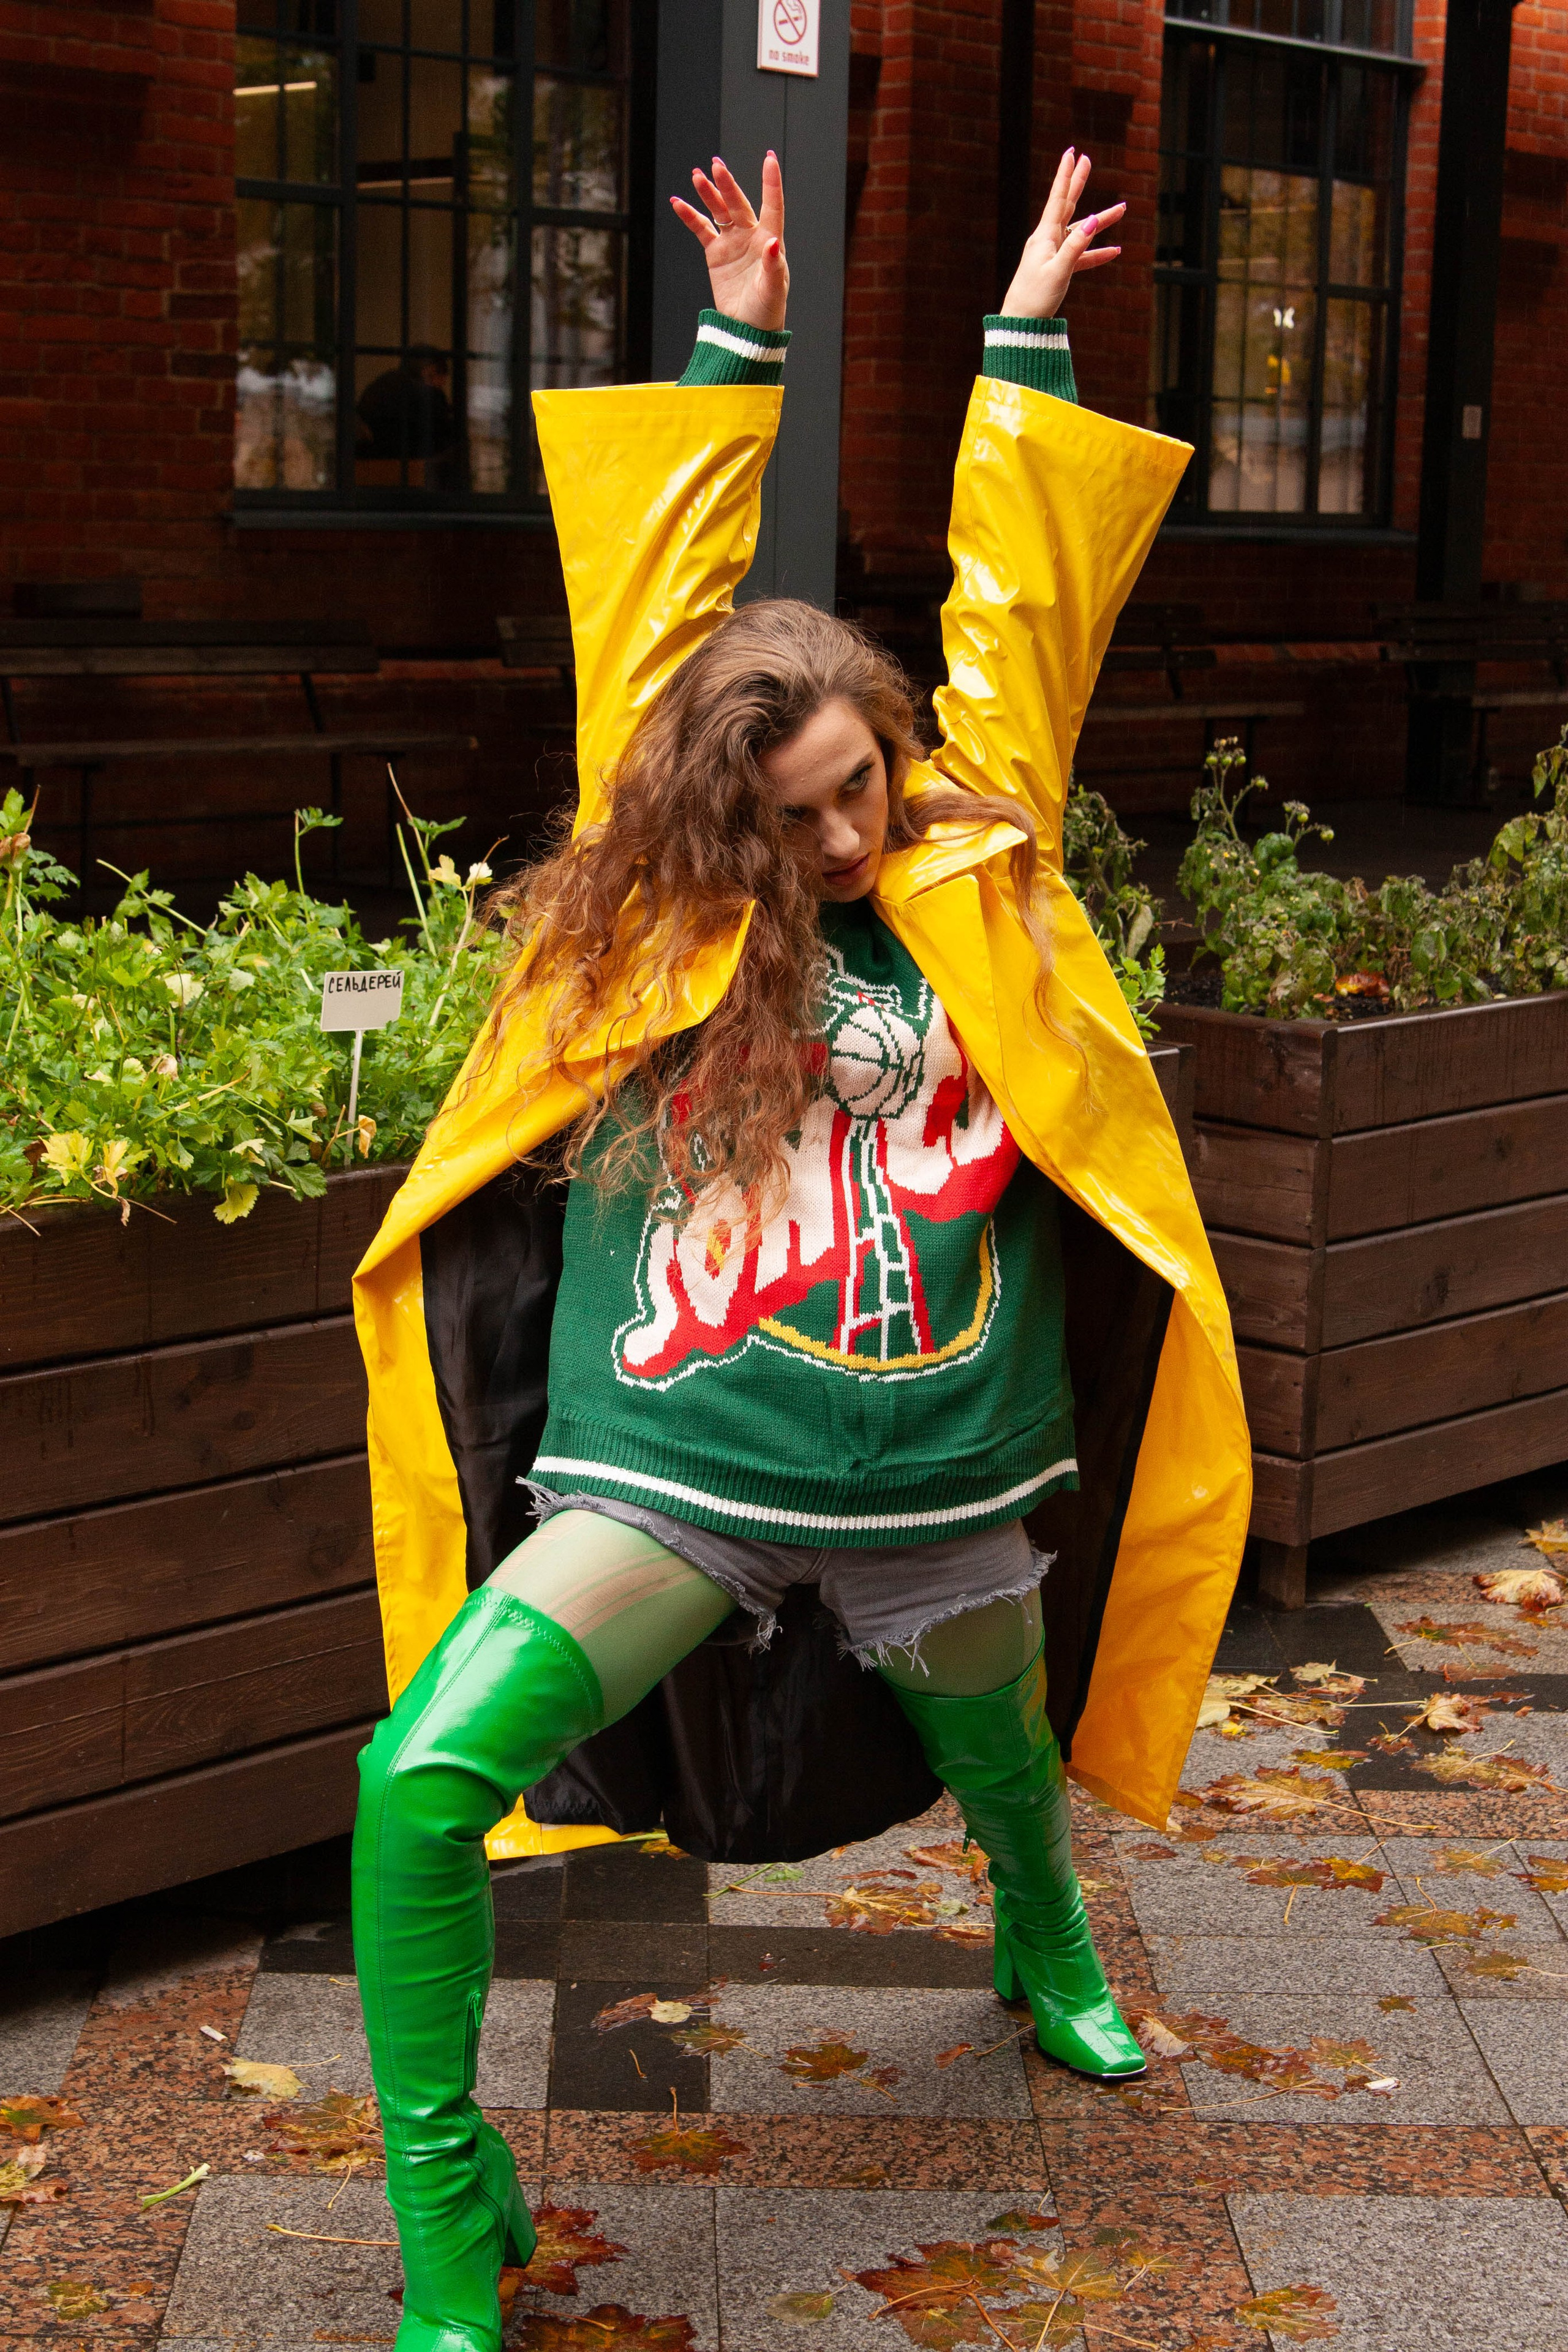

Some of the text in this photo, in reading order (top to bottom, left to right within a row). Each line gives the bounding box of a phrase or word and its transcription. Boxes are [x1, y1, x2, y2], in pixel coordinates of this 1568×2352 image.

[769, 50, 809, 66] no smoke
[328, 970, 402, 993] СЕЛЬДЕРЕЙ
